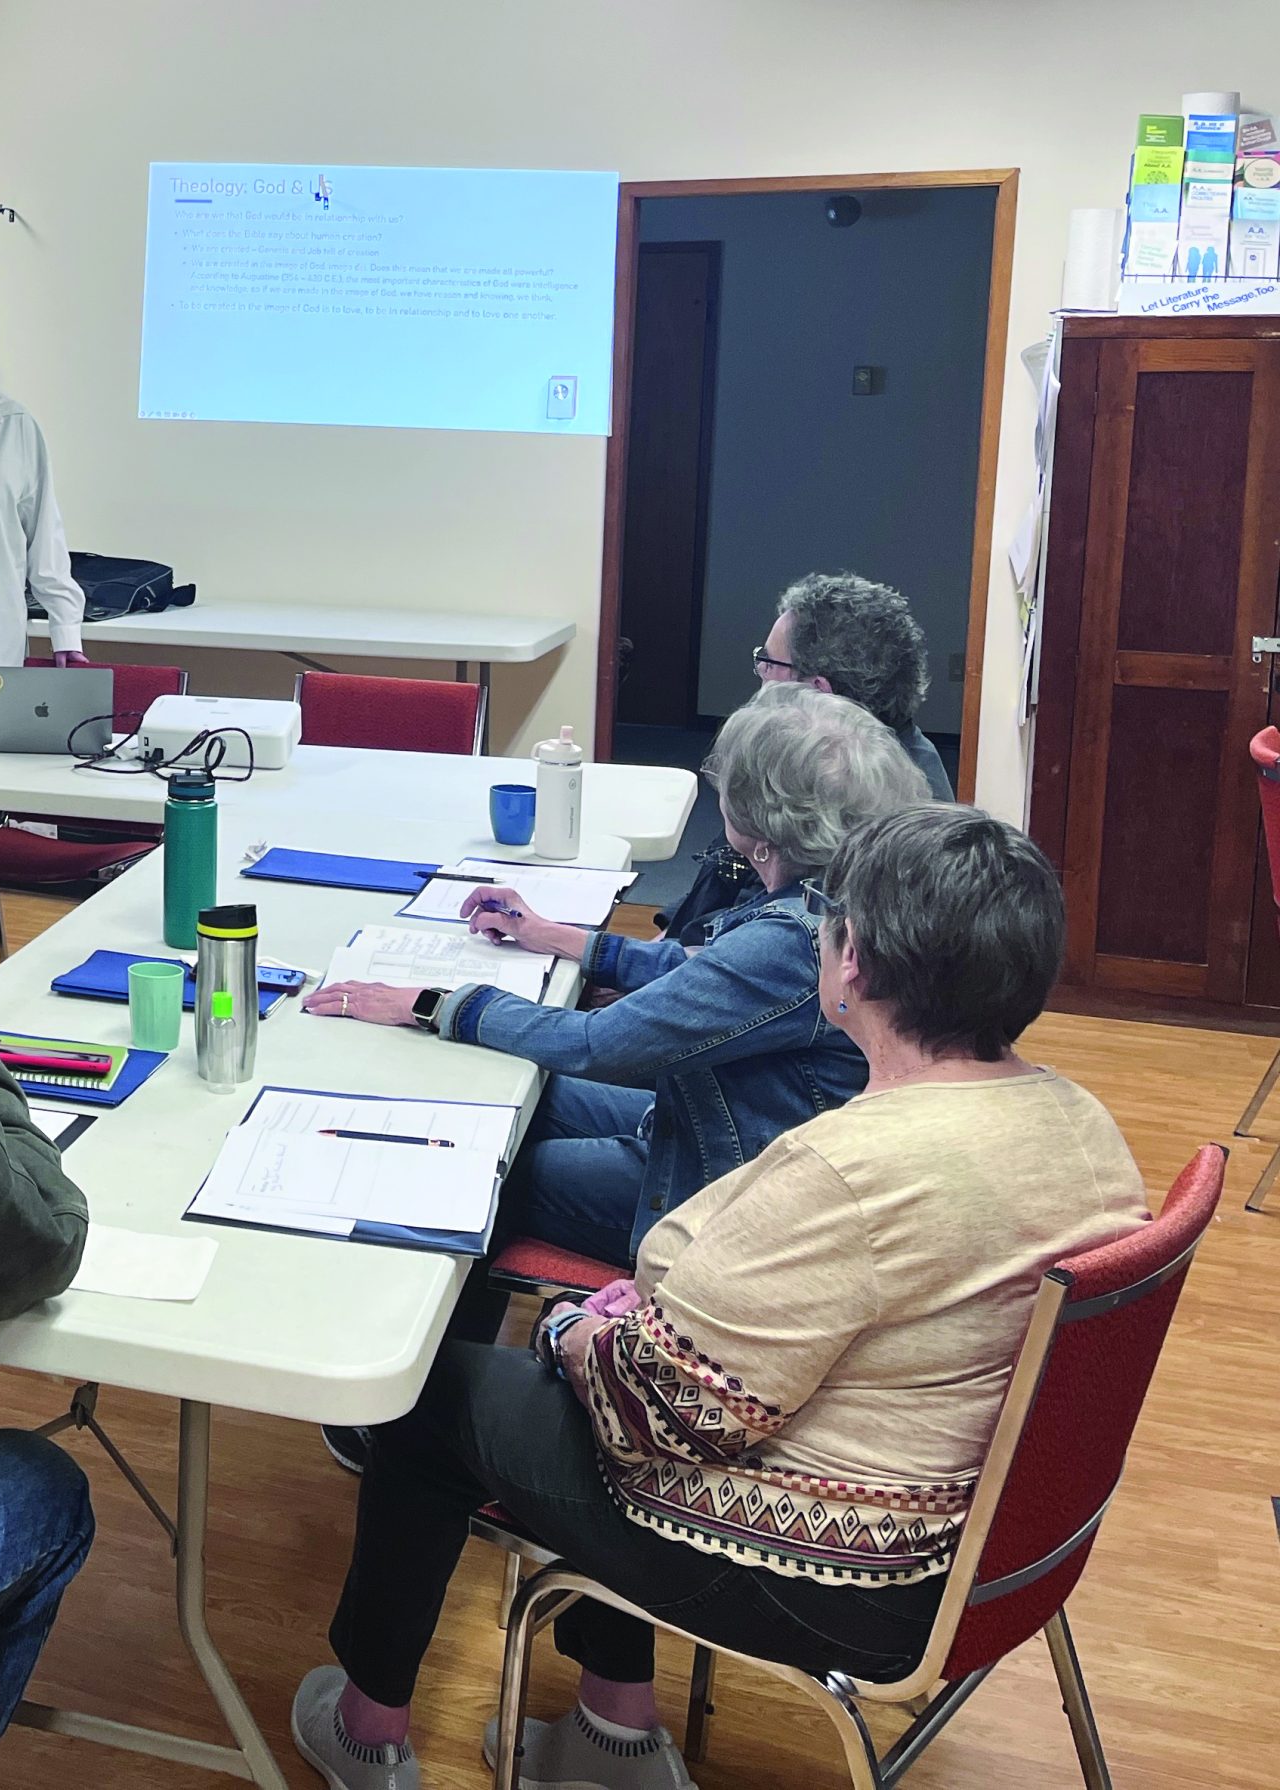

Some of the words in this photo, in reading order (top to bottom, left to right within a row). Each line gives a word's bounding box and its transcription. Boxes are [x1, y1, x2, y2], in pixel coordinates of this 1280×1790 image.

[169, 178, 247, 197] Theology:
[254, 178, 285, 194] God
[291, 180, 303, 195] &
[175, 211, 192, 219] Who
[227, 212, 242, 220] that
[245, 212, 262, 221] God
[265, 213, 289, 221] would
[291, 213, 303, 221] be
[305, 213, 313, 222] in
[314, 213, 365, 224] relationship
[368, 214, 386, 223] with
[389, 215, 403, 223] us?
[192, 245, 203, 253] We
[291, 247, 305, 255] and
[307, 247, 321, 255] Job
[323, 247, 336, 255] tell
[338, 248, 346, 256] of
[347, 248, 379, 256] creation
[192, 260, 204, 268] We
[251, 261, 258, 269] in
[260, 261, 272, 269] the
[274, 261, 298, 272] image
[300, 262, 308, 270] of
[370, 263, 390, 272] Does
[392, 264, 406, 272] this
[432, 265, 447, 273] that
[479, 266, 500, 274] made
[503, 266, 512, 274] all
[515, 266, 554, 277] powerful?
[190, 272, 229, 282] According
[231, 273, 239, 281] to
[241, 273, 279, 284] Augustine
[345, 276, 358, 284] the
[361, 276, 380, 284] most
[382, 276, 420, 287] important
[422, 278, 481, 287] characteristics
[483, 279, 491, 287] of
[492, 279, 508, 288] God
[533, 280, 578, 291] intelligence
[190, 284, 204, 292] and
[262, 286, 267, 294] if
[298, 286, 319, 295] made
[321, 287, 329, 295] in
[330, 287, 343, 295] the
[345, 288, 369, 298] image
[371, 288, 379, 296] of
[414, 289, 432, 298] have
[463, 291, 479, 299] and
[1141, 302, 1158, 313] Let
[1159, 286, 1209, 307] Literature
[179, 301, 189, 310] To
[191, 301, 201, 310] be
[238, 303, 246, 312] in
[248, 303, 262, 312] the
[264, 303, 290, 315] image
[291, 304, 301, 313] of
[302, 304, 320, 314] God
[322, 305, 330, 314] is
[332, 305, 341, 314] to
[343, 306, 362, 317] love,
[365, 306, 374, 315] to
[376, 306, 386, 315] be
[389, 307, 397, 316] in
[399, 307, 451, 319] relationship
[453, 308, 470, 317] and
[471, 309, 480, 318] to
[483, 309, 500, 318] love
[1172, 299, 1201, 313] Carry
[1202, 293, 1220, 303] the
